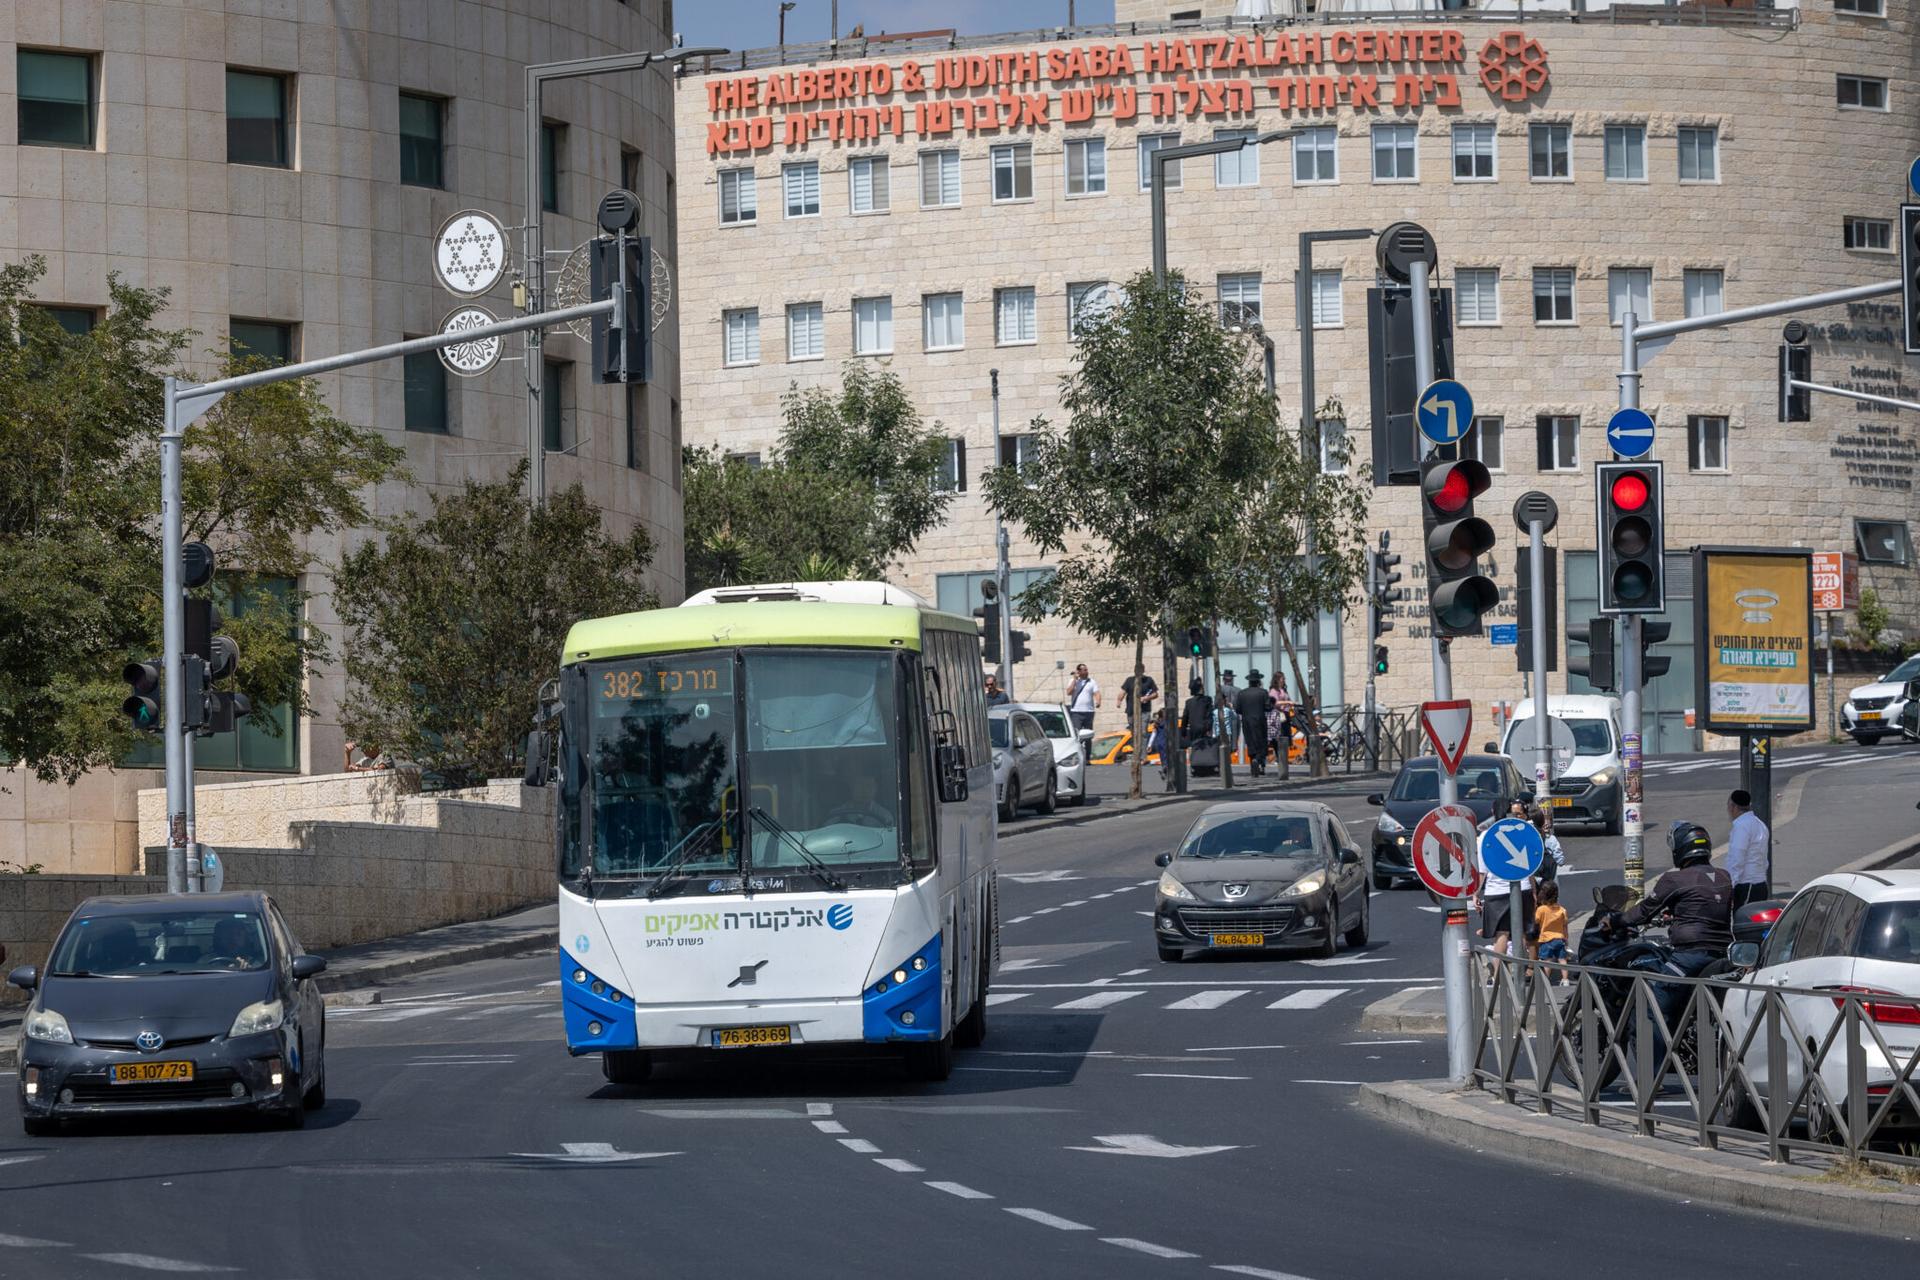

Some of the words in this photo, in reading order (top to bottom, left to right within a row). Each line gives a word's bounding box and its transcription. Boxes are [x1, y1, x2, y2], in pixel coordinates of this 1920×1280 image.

[705, 77, 758, 113] THE
[764, 63, 893, 107] ALBERTO
[902, 60, 925, 93] &
[932, 51, 1039, 90] JUDITH
[1046, 44, 1134, 81] SABA
[1143, 31, 1322, 73] HATZALAH
[1330, 29, 1464, 64] CENTER
[1150, 75, 1254, 116] הצלה
[1266, 74, 1379, 110] איחוד
[1393, 74, 1462, 107] בית
[914, 87, 1050, 135] אלברטו
[705, 116, 773, 154] סבא
[783, 105, 903, 146] ויהודית
[1851, 365, 1891, 380] Dedicated
[1714, 635, 1748, 649] החופש
[1751, 636, 1765, 649] את
[1768, 636, 1802, 650] מאירים
[603, 671, 643, 698] 382
[657, 669, 718, 691] מרכז
[644, 912, 720, 936] אפיקים
[724, 907, 824, 932] אלקטרה
[646, 937, 674, 948] להגיע
[677, 937, 704, 948] פשוט
